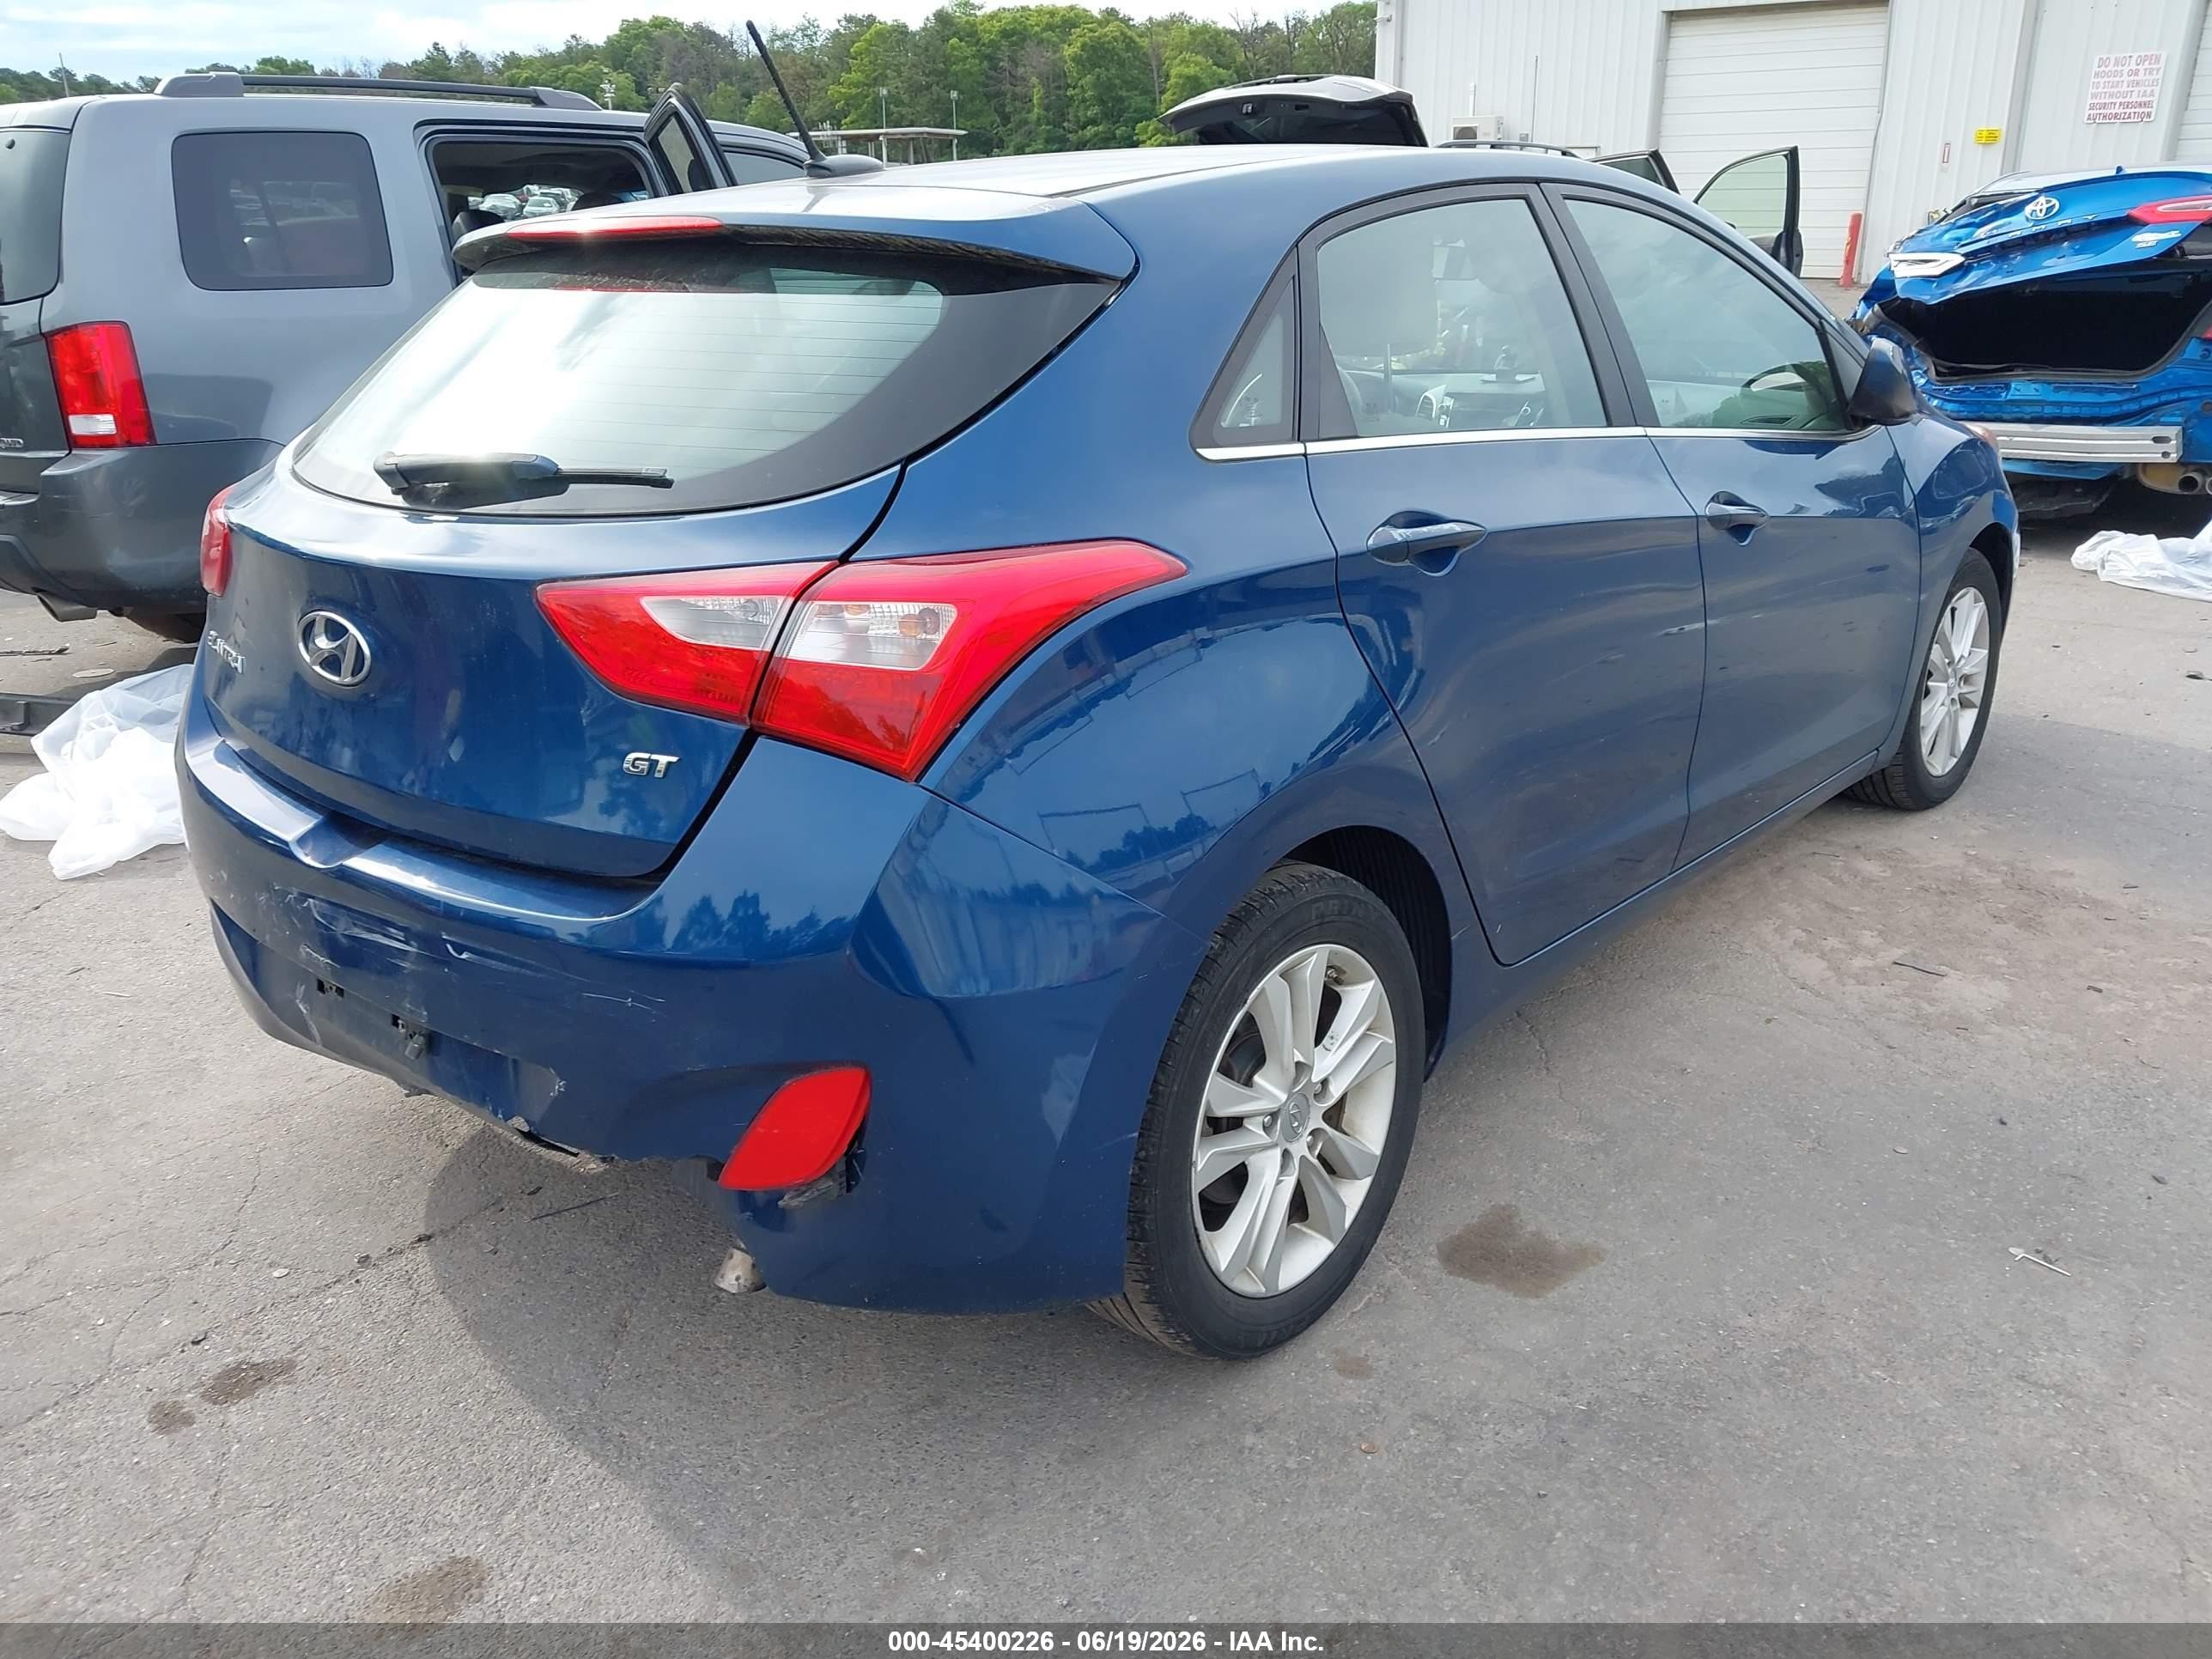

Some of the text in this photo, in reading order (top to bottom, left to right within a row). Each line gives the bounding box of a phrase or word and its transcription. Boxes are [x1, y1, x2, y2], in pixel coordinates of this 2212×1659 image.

[2097, 53, 2161, 68] DO NOT OPEN
[2094, 67, 2161, 79] HOODS OR TRY
[2092, 78, 2159, 90] TO START VEHICLES
[2090, 88, 2154, 100] WITHOUT IAA
[2088, 100, 2154, 111] SECURITY PERSONNEL
[2087, 112, 2152, 121] AUTHORIZATION
[622, 752, 681, 779] GT
